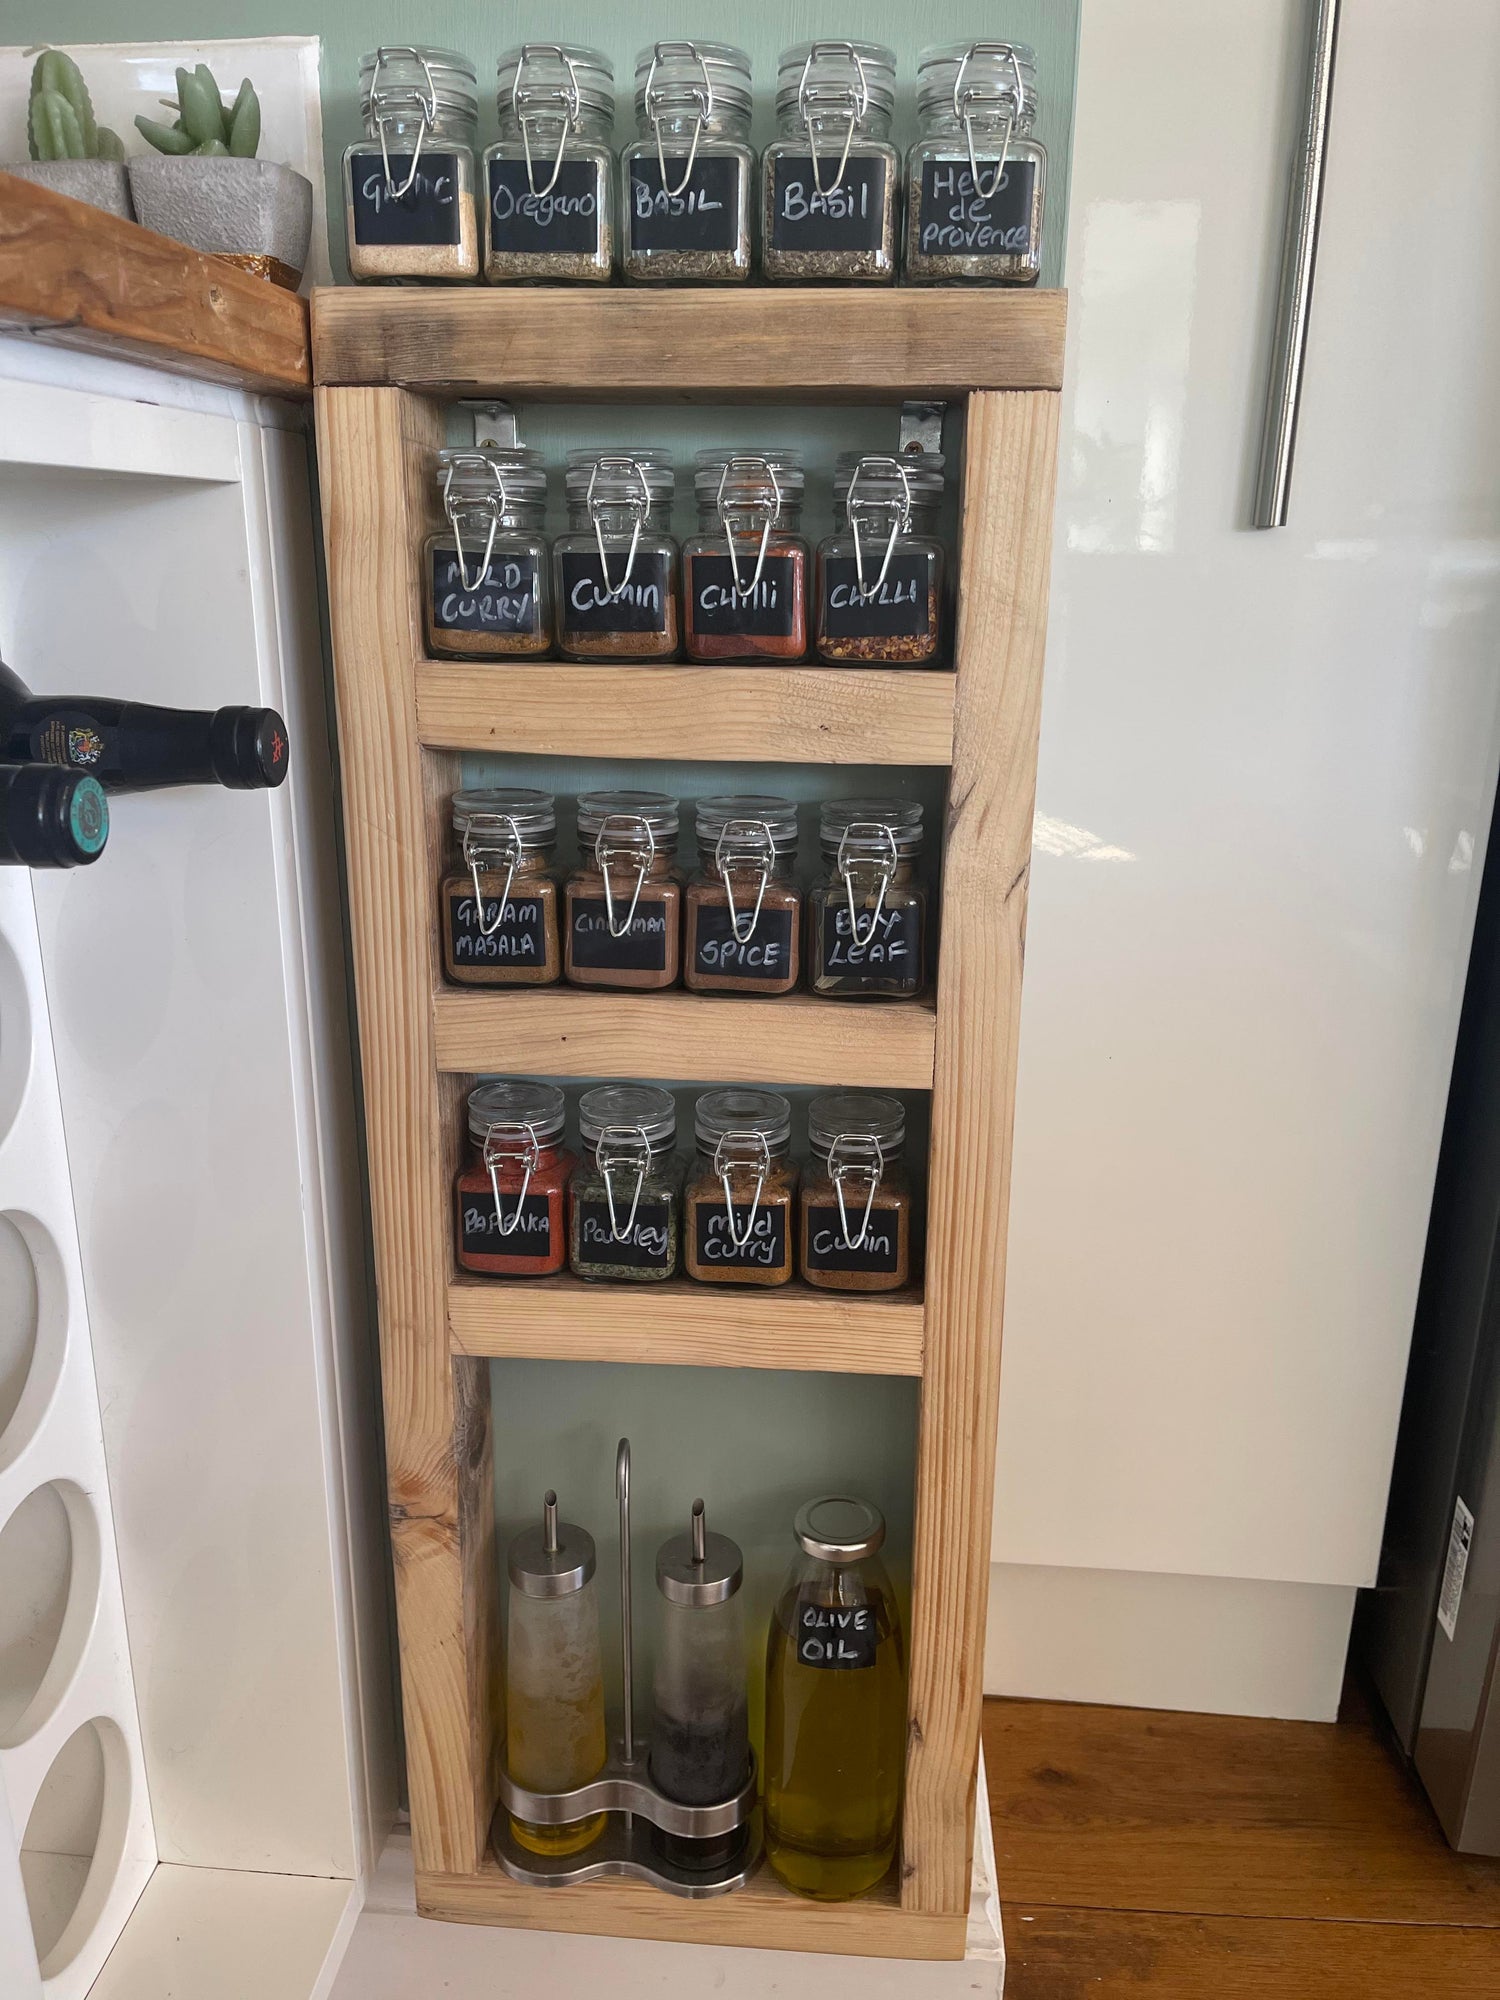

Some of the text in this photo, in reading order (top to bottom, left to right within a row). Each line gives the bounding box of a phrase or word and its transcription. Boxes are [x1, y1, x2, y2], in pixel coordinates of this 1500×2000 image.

[493, 185, 596, 226] Oregano
[949, 196, 992, 222] de
[448, 561, 521, 590] MILD
[442, 593, 529, 622] CURRY
[830, 579, 917, 609] CHILLI
[457, 900, 537, 927] GARAM
[736, 912, 753, 937] 5
[836, 909, 902, 939] BAY
[456, 933, 535, 956] MASALA
[700, 939, 780, 968] SPICE
[464, 1207, 549, 1234] PAPRIKA
[803, 1606, 868, 1630] OLIVE
[802, 1637, 858, 1660] OIL
